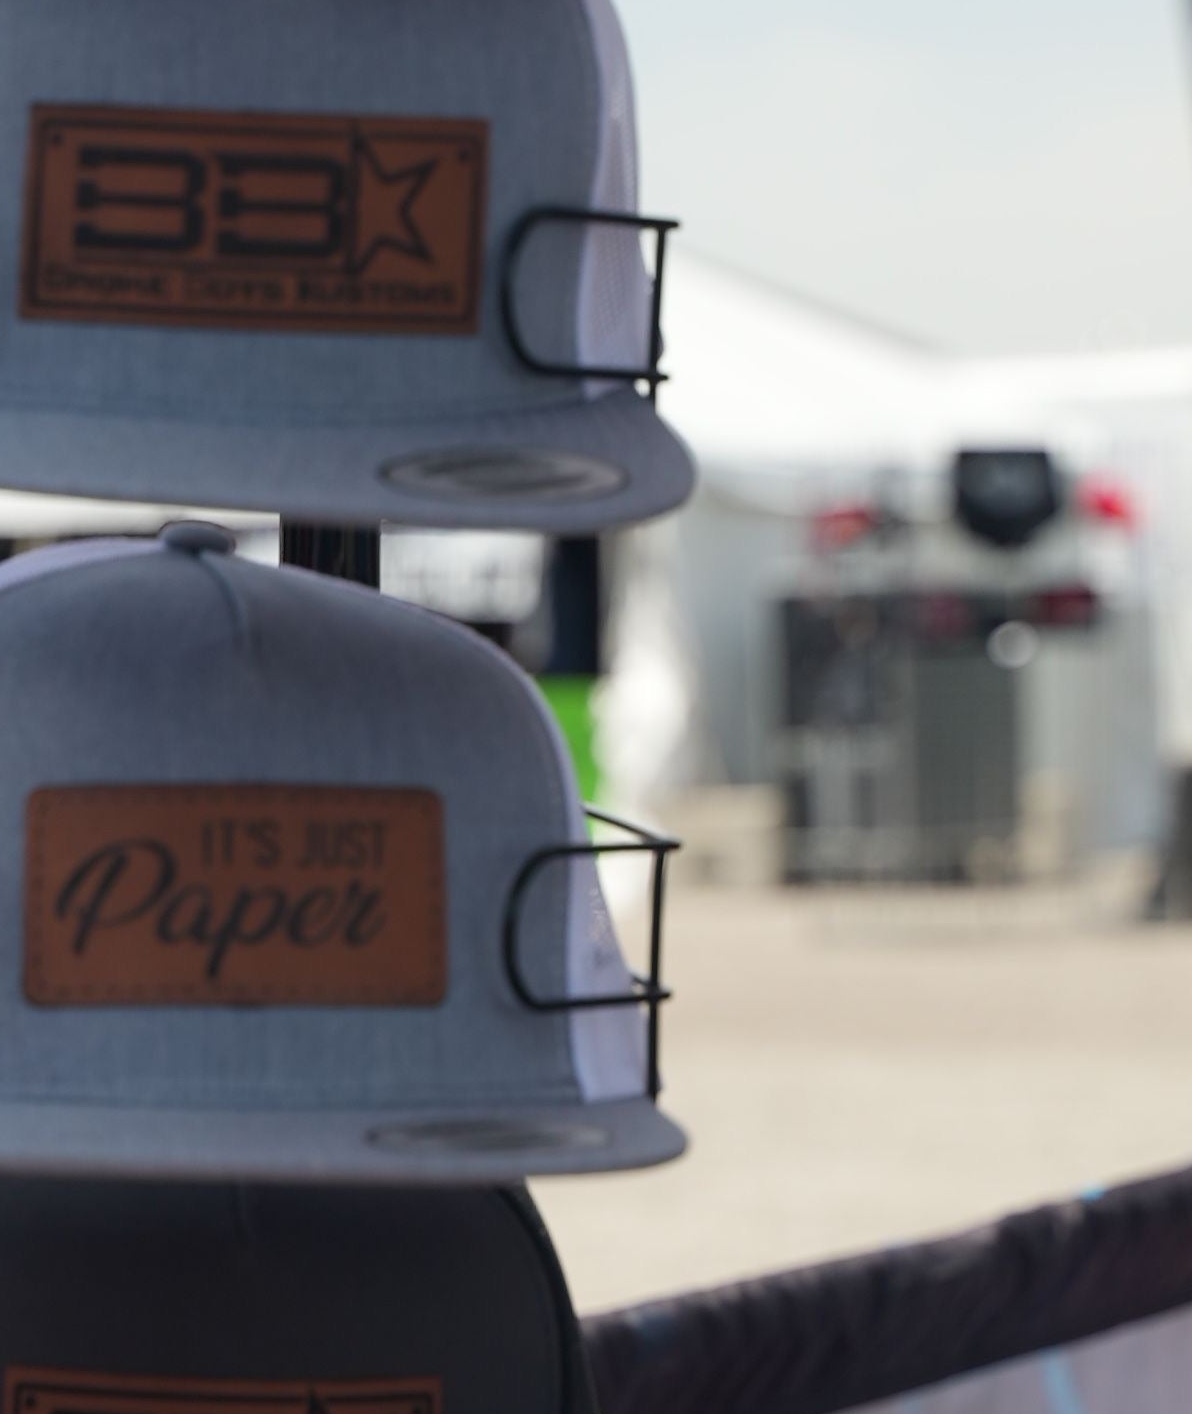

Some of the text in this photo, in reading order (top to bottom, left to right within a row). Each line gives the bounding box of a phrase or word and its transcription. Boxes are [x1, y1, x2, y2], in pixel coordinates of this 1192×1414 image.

[201, 819, 389, 869] IT'S JUST
[54, 837, 387, 979] Paper
